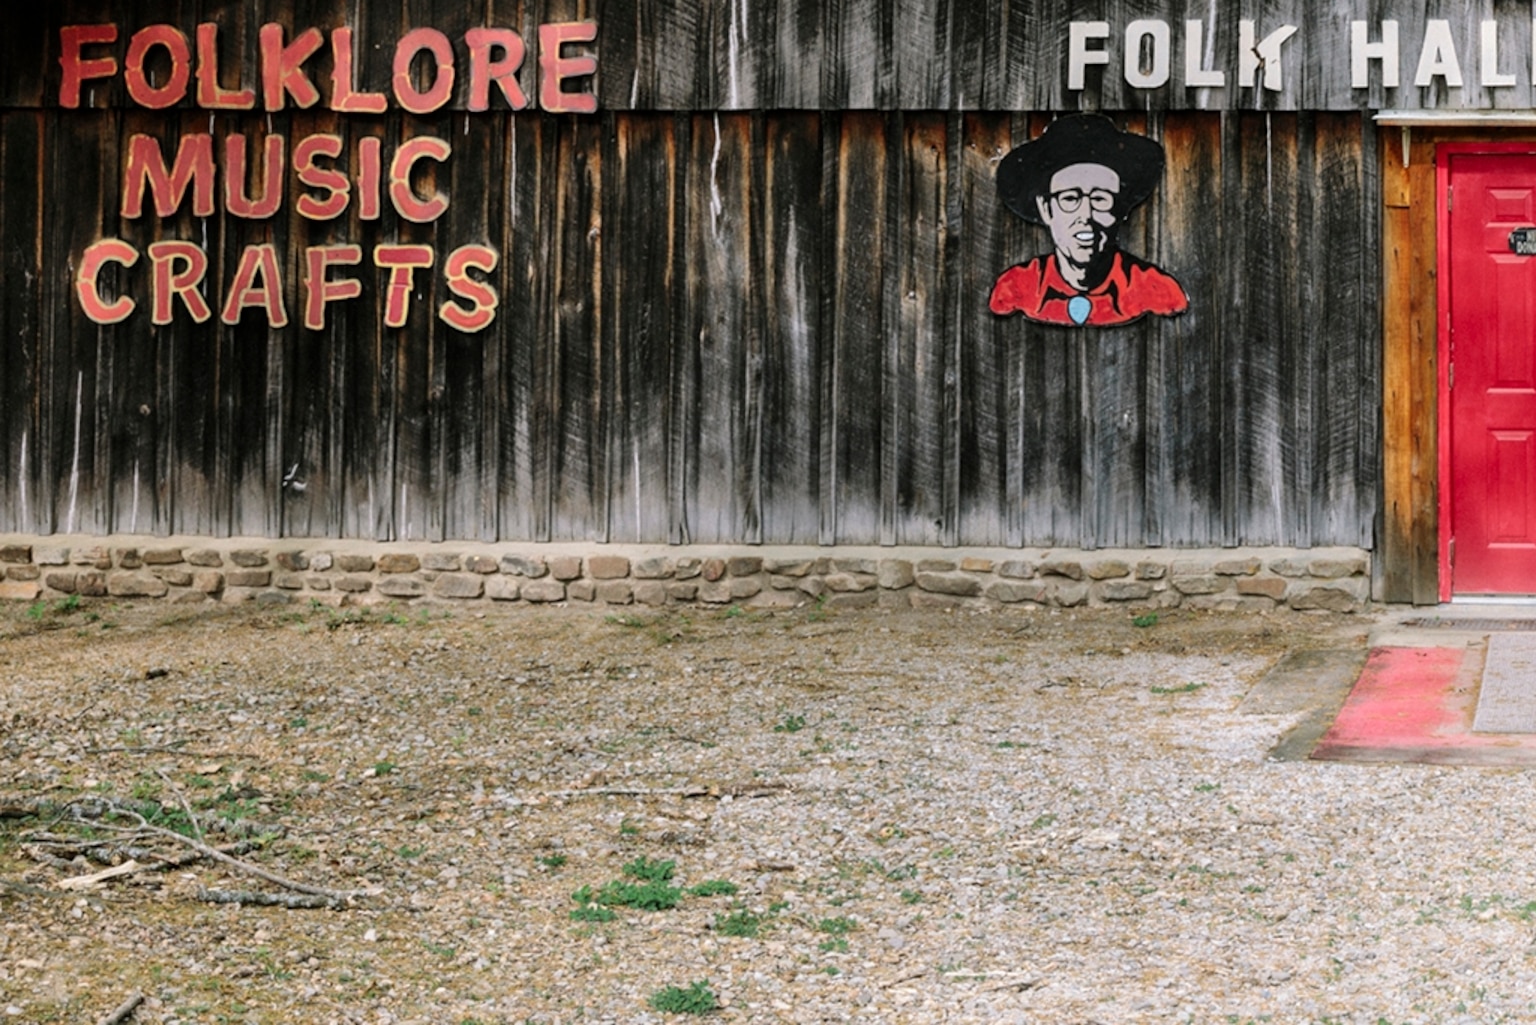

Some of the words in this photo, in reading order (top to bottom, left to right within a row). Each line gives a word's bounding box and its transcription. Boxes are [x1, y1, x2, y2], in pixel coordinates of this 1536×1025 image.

[58, 21, 598, 114] FOLKLORE
[1067, 19, 1298, 92] FOLK
[121, 133, 451, 224] MUSIC
[76, 239, 499, 334] CRAFTS
